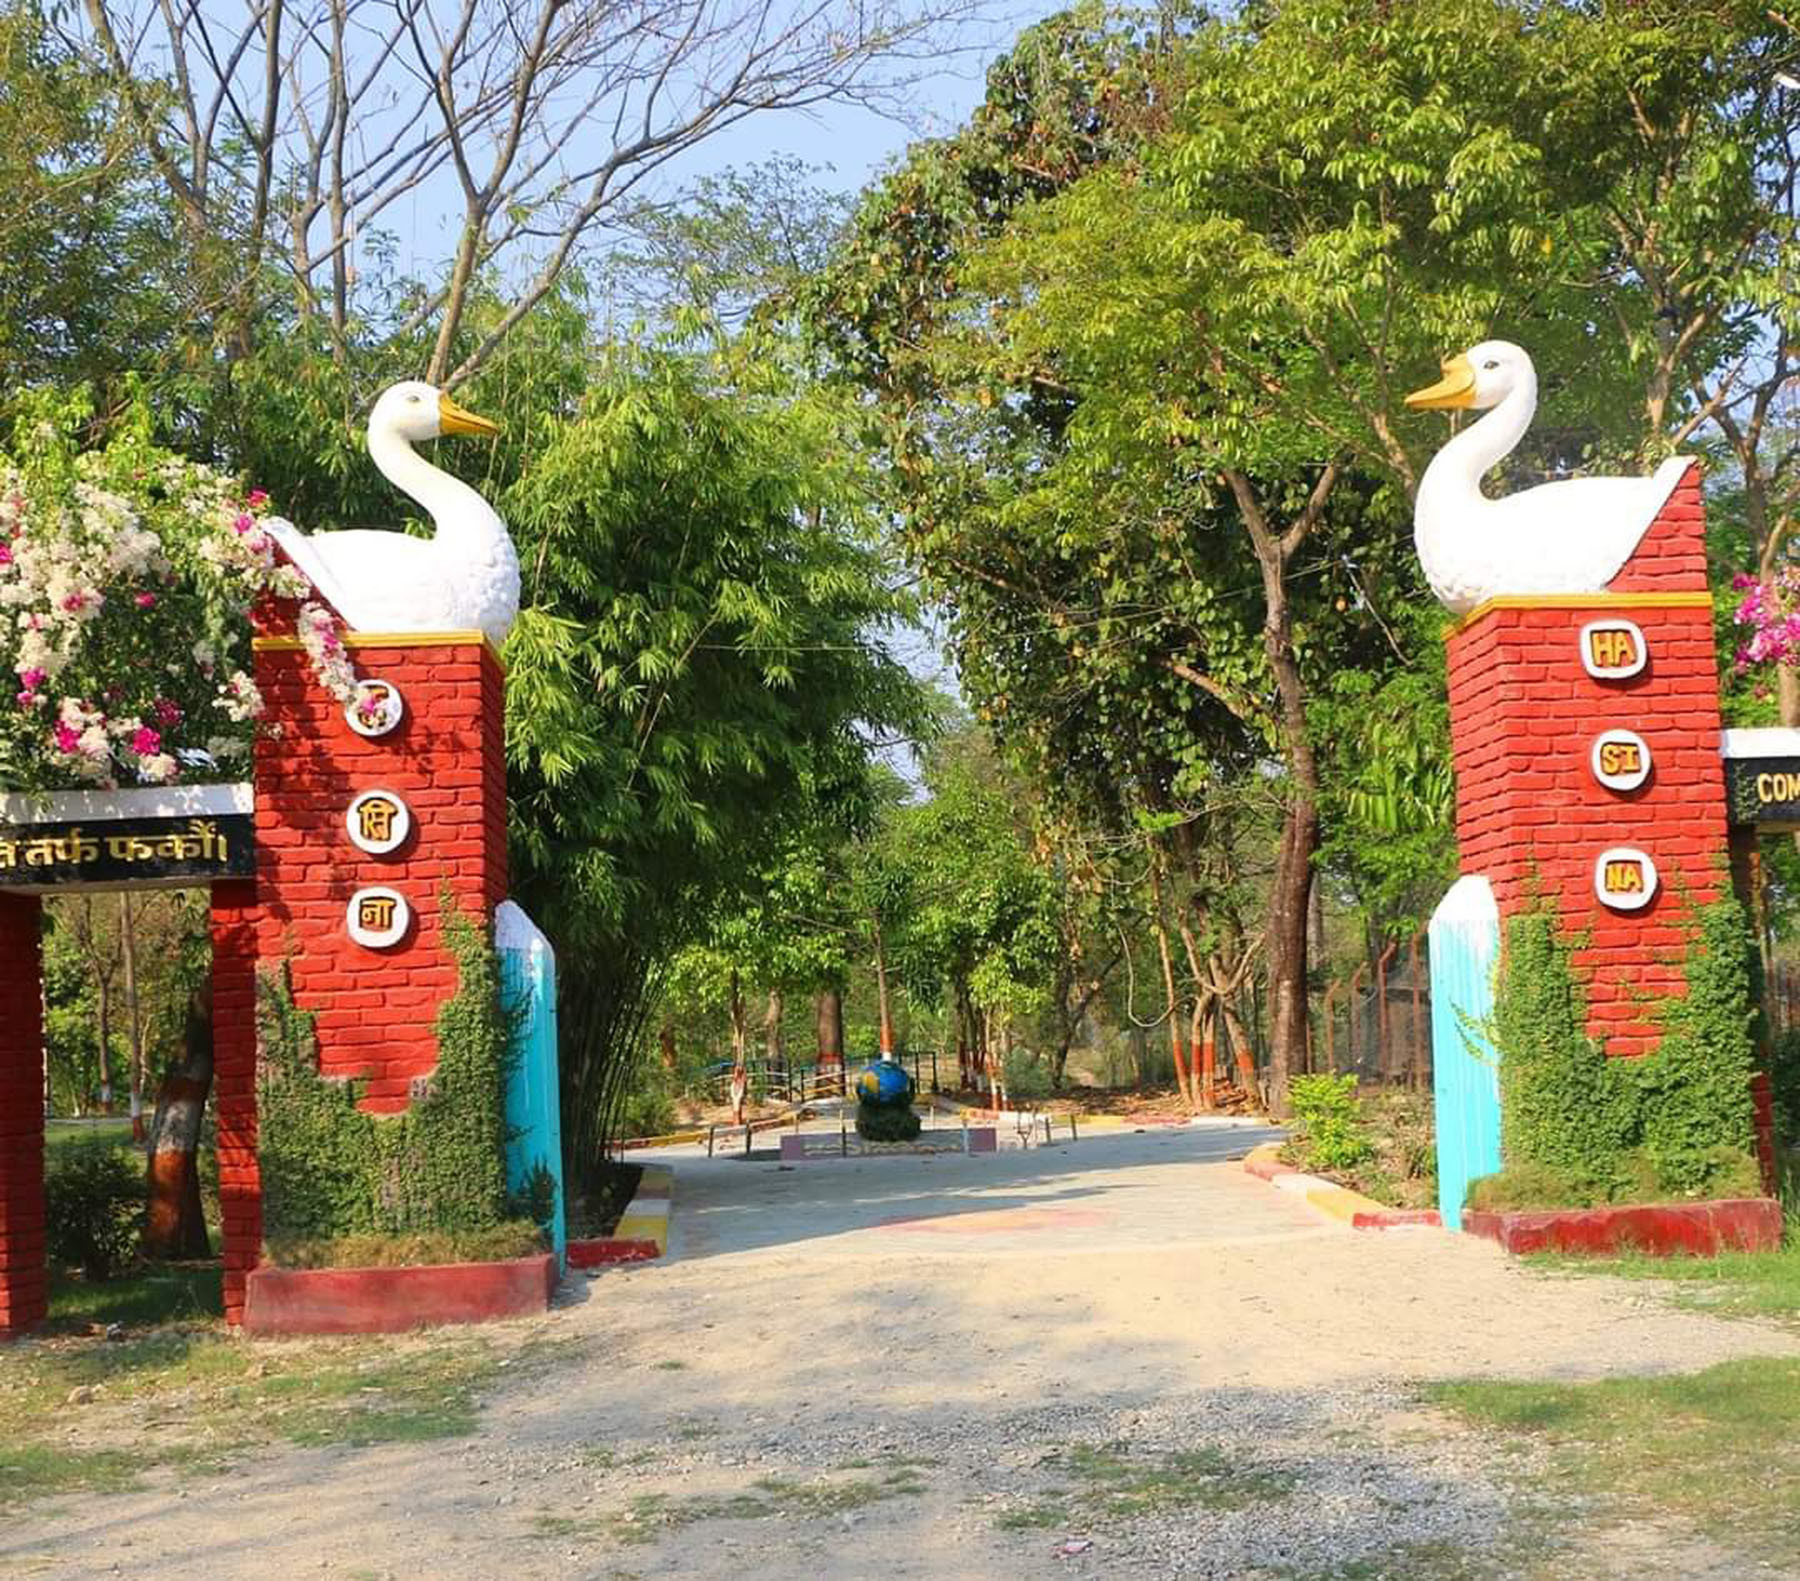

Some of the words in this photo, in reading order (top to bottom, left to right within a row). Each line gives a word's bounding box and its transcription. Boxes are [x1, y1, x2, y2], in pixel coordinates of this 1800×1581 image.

[1591, 629, 1637, 667] HA
[1601, 742, 1642, 775] SI
[25, 827, 99, 866] तर्फ
[1604, 860, 1644, 893] NA
[359, 896, 397, 931] ना
